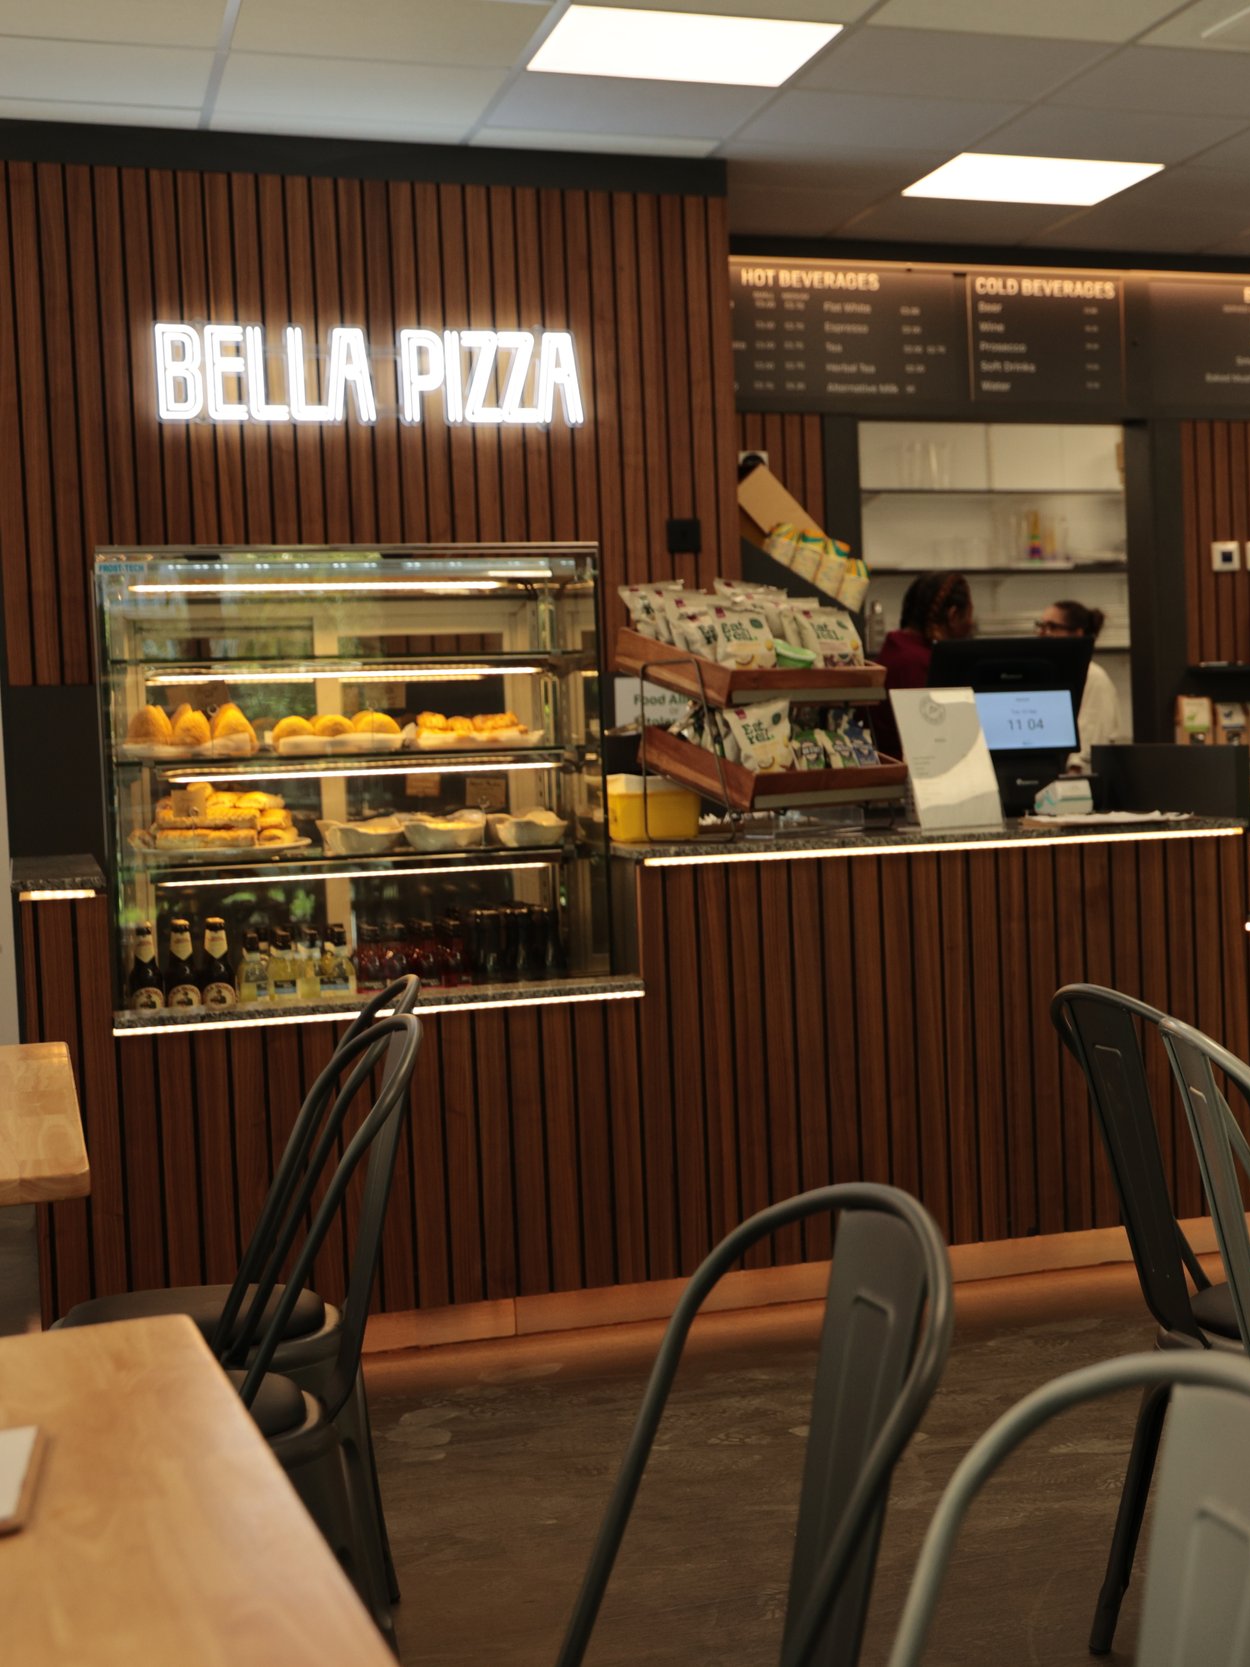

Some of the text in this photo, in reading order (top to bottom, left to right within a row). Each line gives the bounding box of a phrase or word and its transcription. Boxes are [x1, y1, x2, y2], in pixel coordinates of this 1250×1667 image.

[741, 268, 880, 291] HOT BEVERAGES
[975, 276, 1115, 299] COLD BEVERAGES
[823, 301, 873, 315] Flat White
[155, 322, 584, 425] BELLA PIZZA
